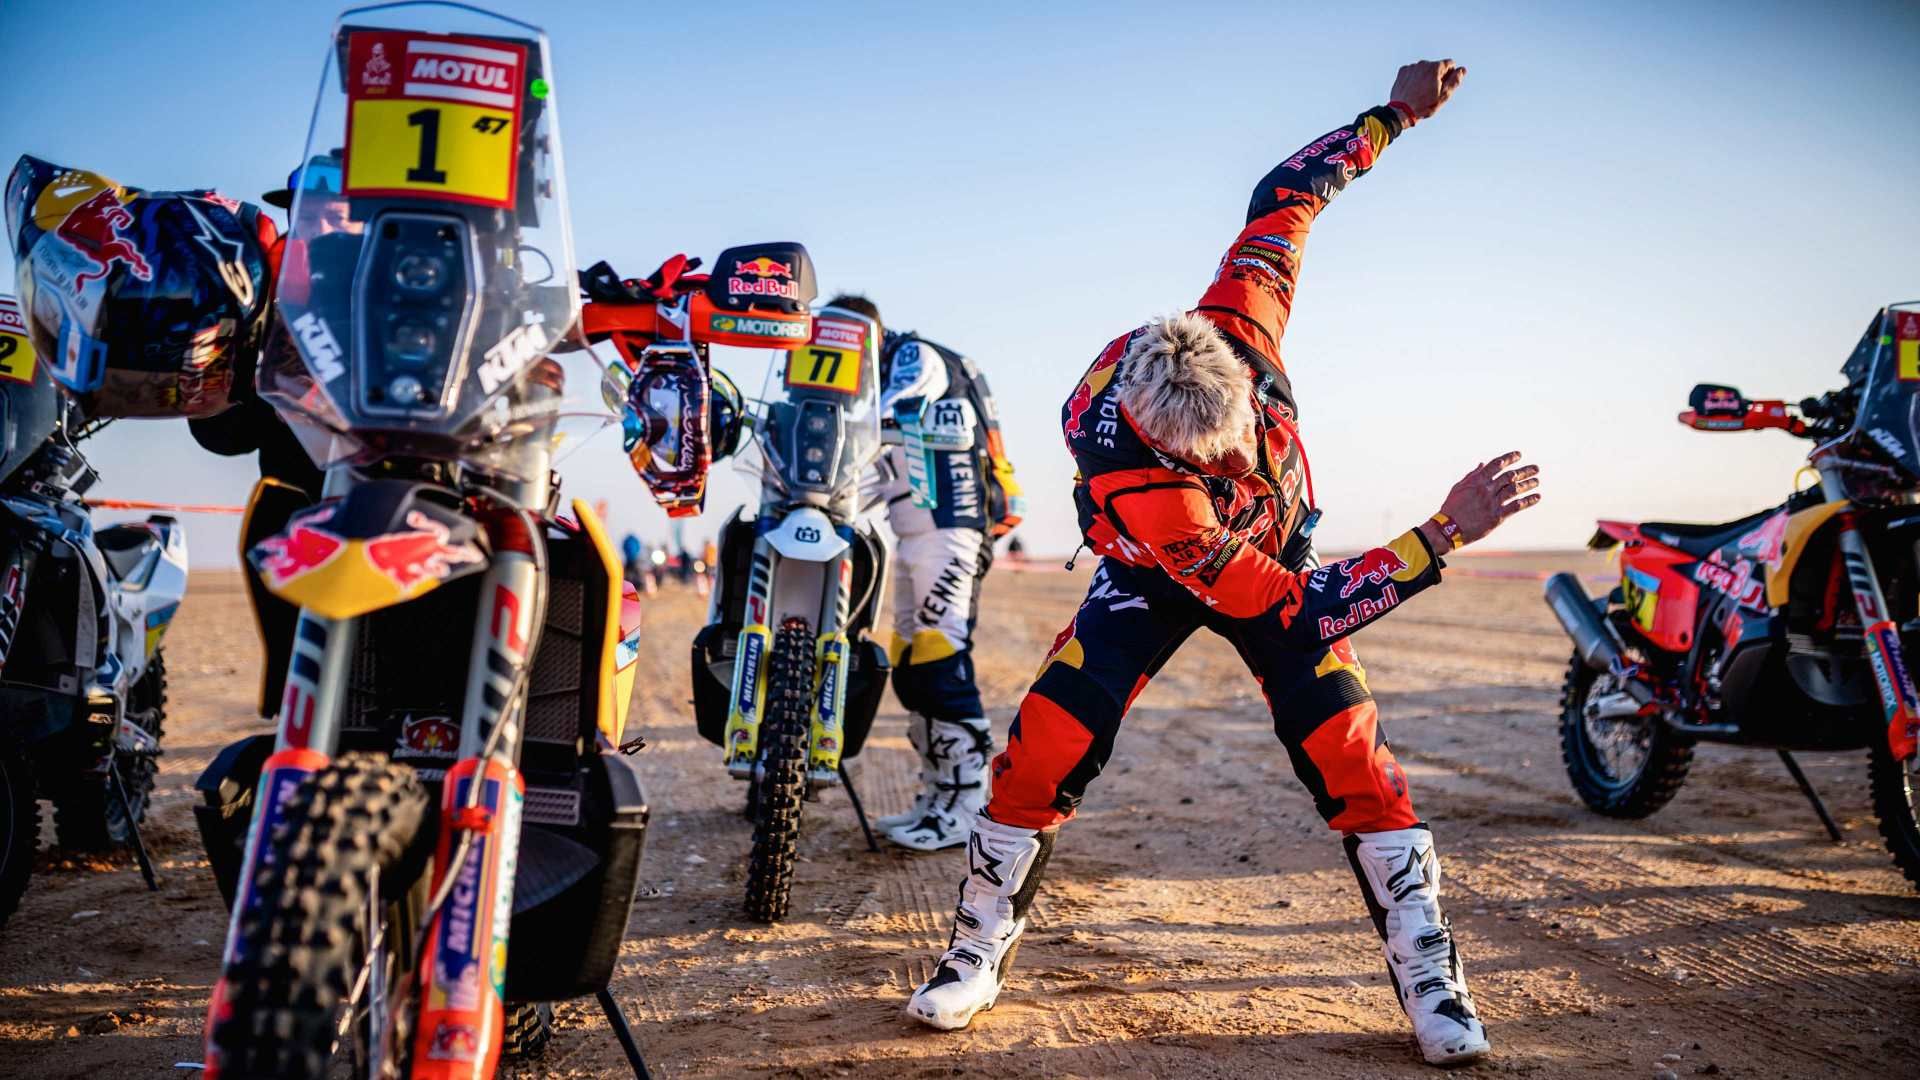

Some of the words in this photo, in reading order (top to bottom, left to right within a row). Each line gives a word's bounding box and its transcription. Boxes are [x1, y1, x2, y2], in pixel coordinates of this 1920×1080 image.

[412, 58, 508, 88] MOTUL
[406, 108, 447, 184] 1
[472, 116, 509, 134] 47
[728, 277, 767, 295] Red
[765, 278, 799, 300] Bull
[292, 312, 345, 384] KTM
[477, 322, 548, 394] KTM
[736, 318, 806, 338] MOTOREX
[809, 348, 843, 383] 77
[948, 452, 979, 518] KENNY
[917, 558, 974, 628] KENNY
[1318, 603, 1360, 640] Red
[1358, 583, 1399, 622] Bull
[742, 638, 760, 703] MICHELIN
